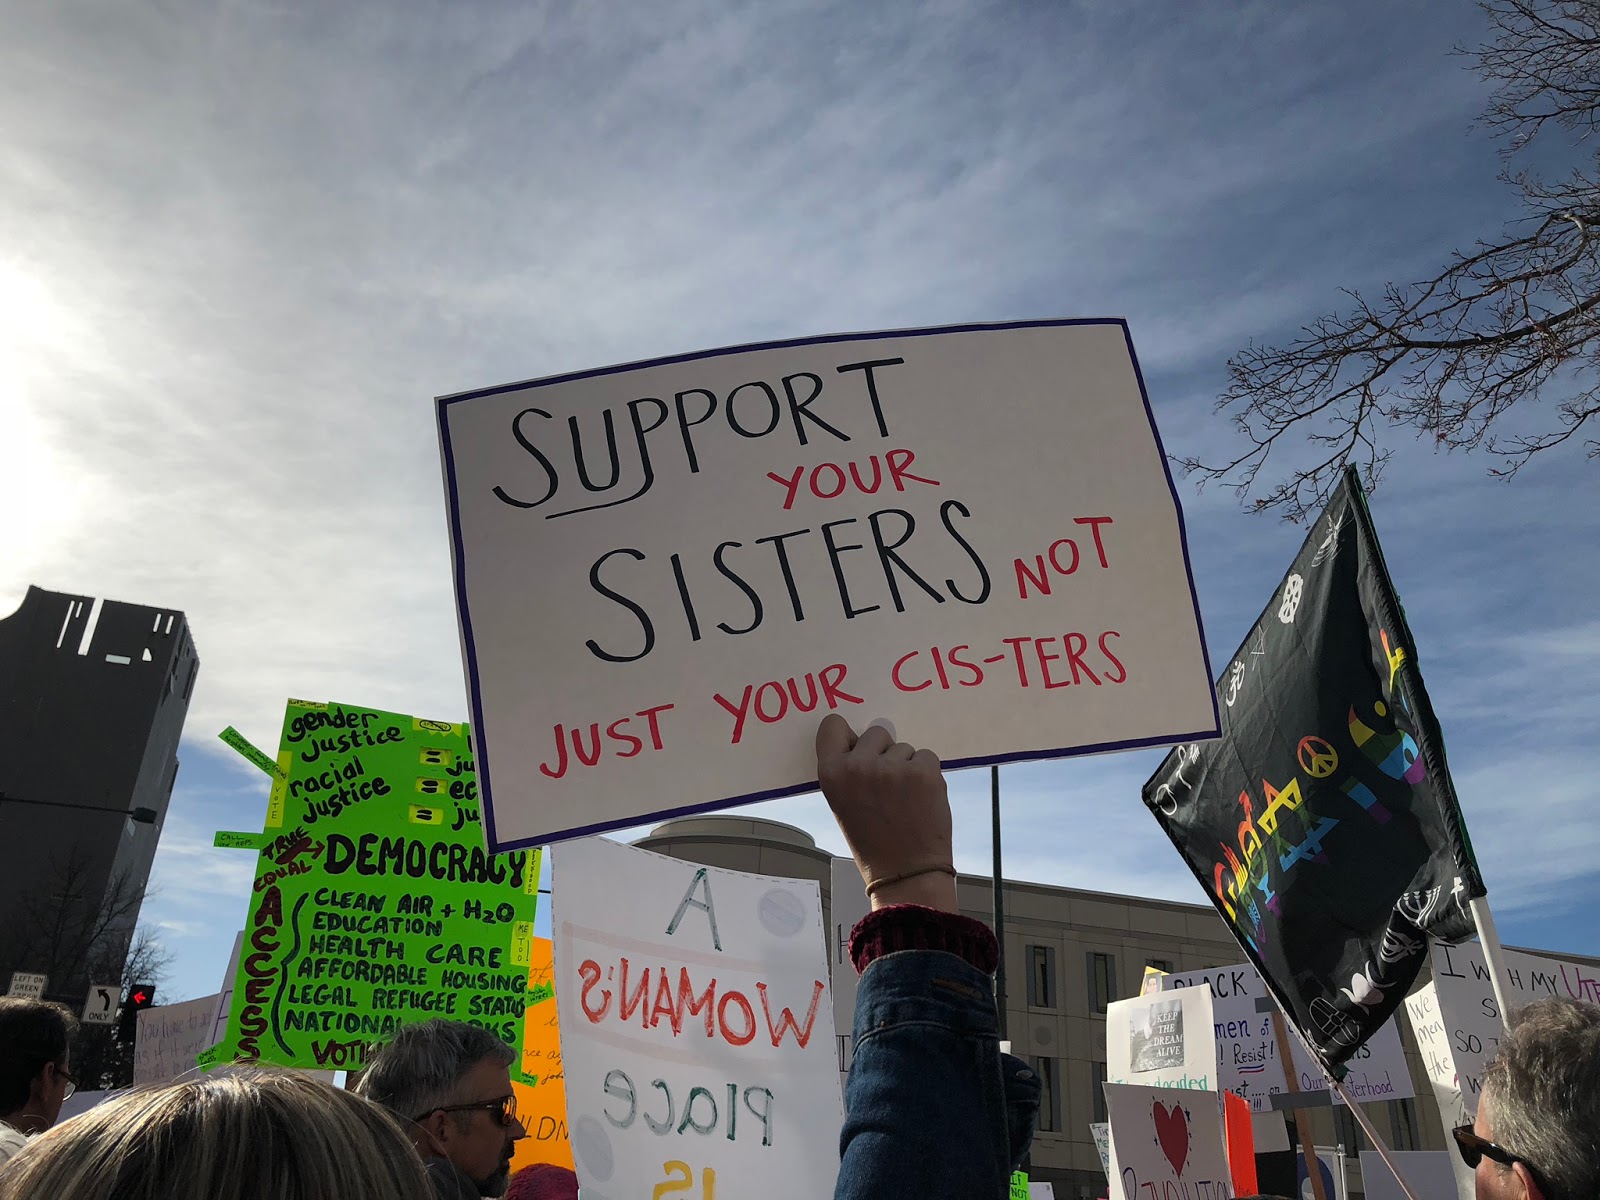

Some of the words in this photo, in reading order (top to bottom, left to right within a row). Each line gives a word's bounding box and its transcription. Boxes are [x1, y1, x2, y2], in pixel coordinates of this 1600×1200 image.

[492, 357, 904, 519] SUPPORT
[767, 449, 940, 509] YOUR
[585, 499, 991, 663] SISTERS
[1014, 516, 1113, 599] NOT
[539, 703, 675, 778] JUST
[713, 663, 864, 743] YOUR
[891, 630, 1127, 691] CIS-TERS
[287, 706, 379, 742] gender
[301, 729, 405, 762] justice
[290, 755, 364, 797] racial
[303, 777, 391, 823] justice
[323, 833, 526, 888] DEMOCRACY
[314, 888, 387, 914] CLEAN
[397, 893, 433, 917] AIR
[313, 911, 442, 936] EDUCATION
[309, 934, 404, 960] HEALTH
[426, 944, 502, 969] CARE
[298, 957, 427, 986] AFFORDABLE
[441, 969, 527, 994] HOUSING
[1173, 971, 1248, 998] ACK
[1434, 943, 1465, 978] I
[1531, 970, 1559, 996] MY
[14, 984, 39, 992] GREEN
[288, 983, 358, 1007] LEGAL
[372, 988, 457, 1014] REFUGEE
[89, 1012, 109, 1020] ONLY
[1157, 1011, 1178, 1023] KEEP
[1158, 1023, 1175, 1034] THE
[1260, 1018, 1269, 1036] of
[1154, 1034, 1183, 1046] DREAM
[1156, 1046, 1180, 1058] ALIVE
[1301, 1072, 1323, 1090] Our
[1428, 1051, 1450, 1081] the
